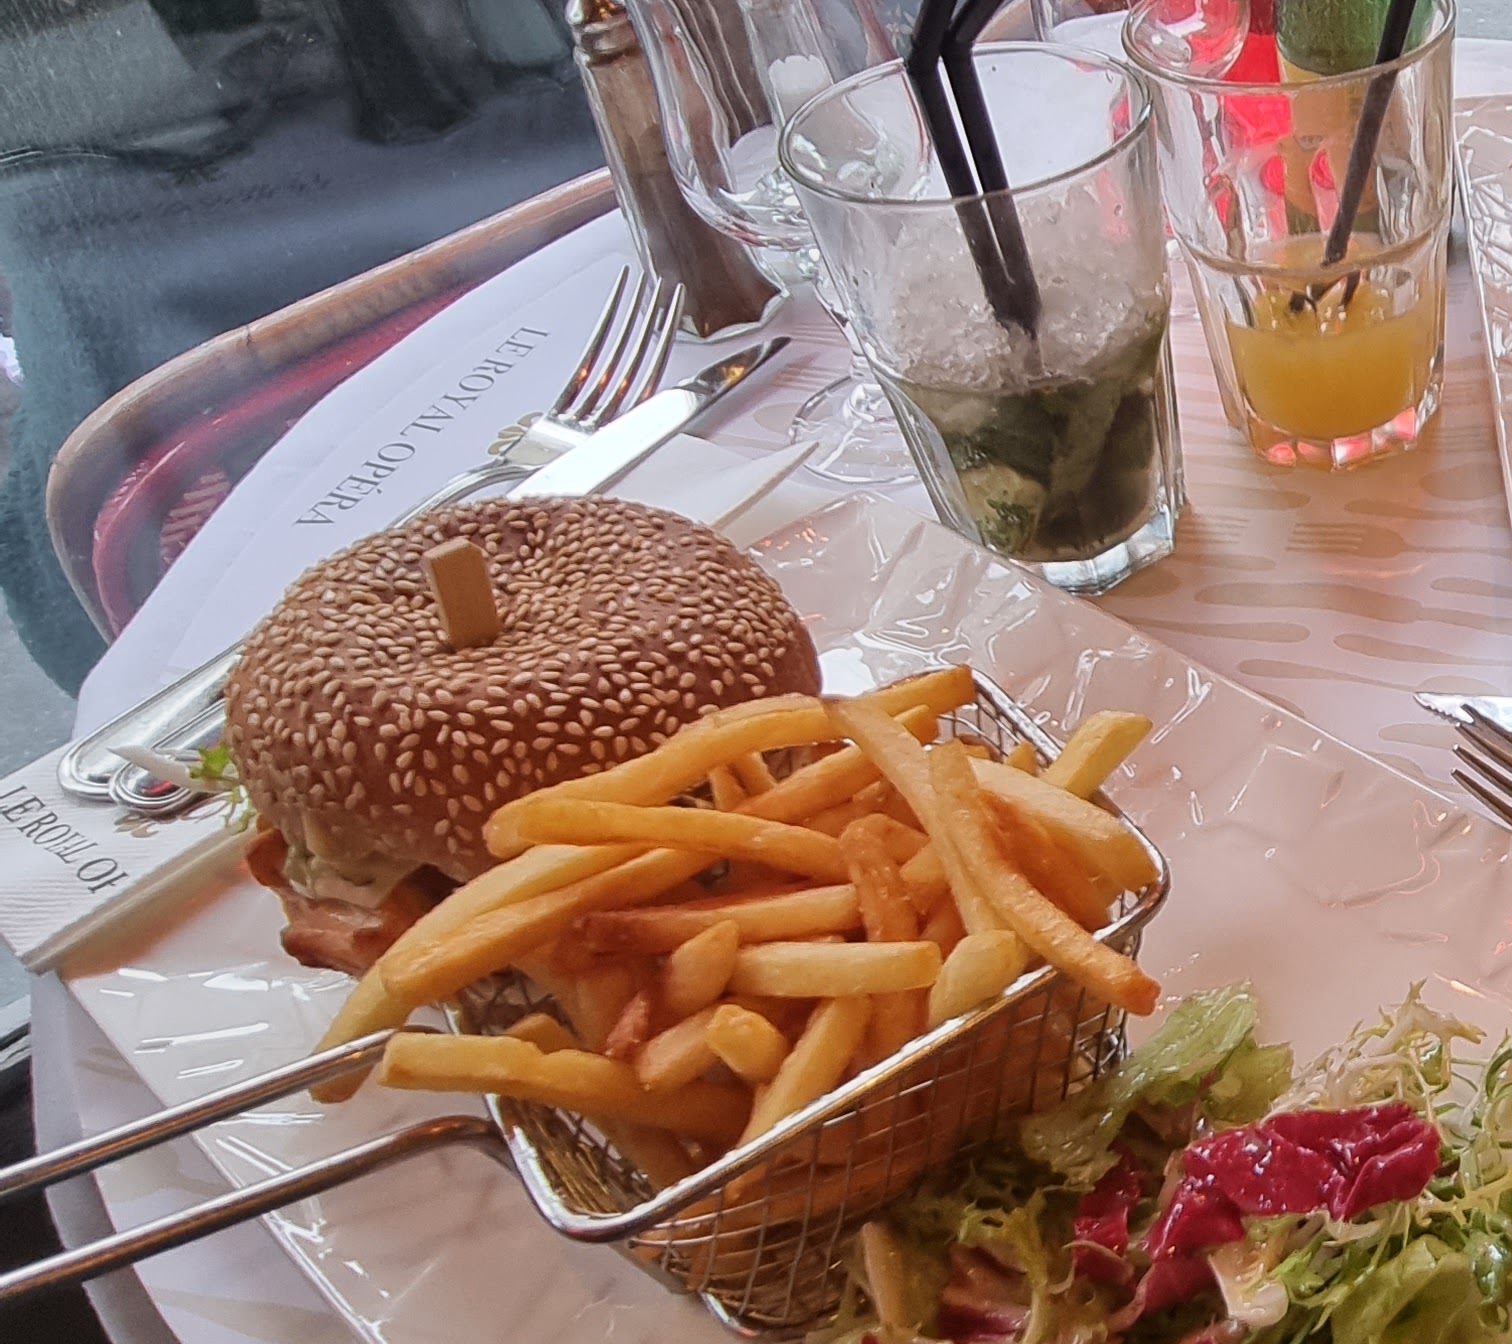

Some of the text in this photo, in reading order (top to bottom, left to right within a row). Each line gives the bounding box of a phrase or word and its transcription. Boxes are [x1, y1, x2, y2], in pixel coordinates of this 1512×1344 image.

[292, 327, 549, 527] LE ROYAL OPÉRA
